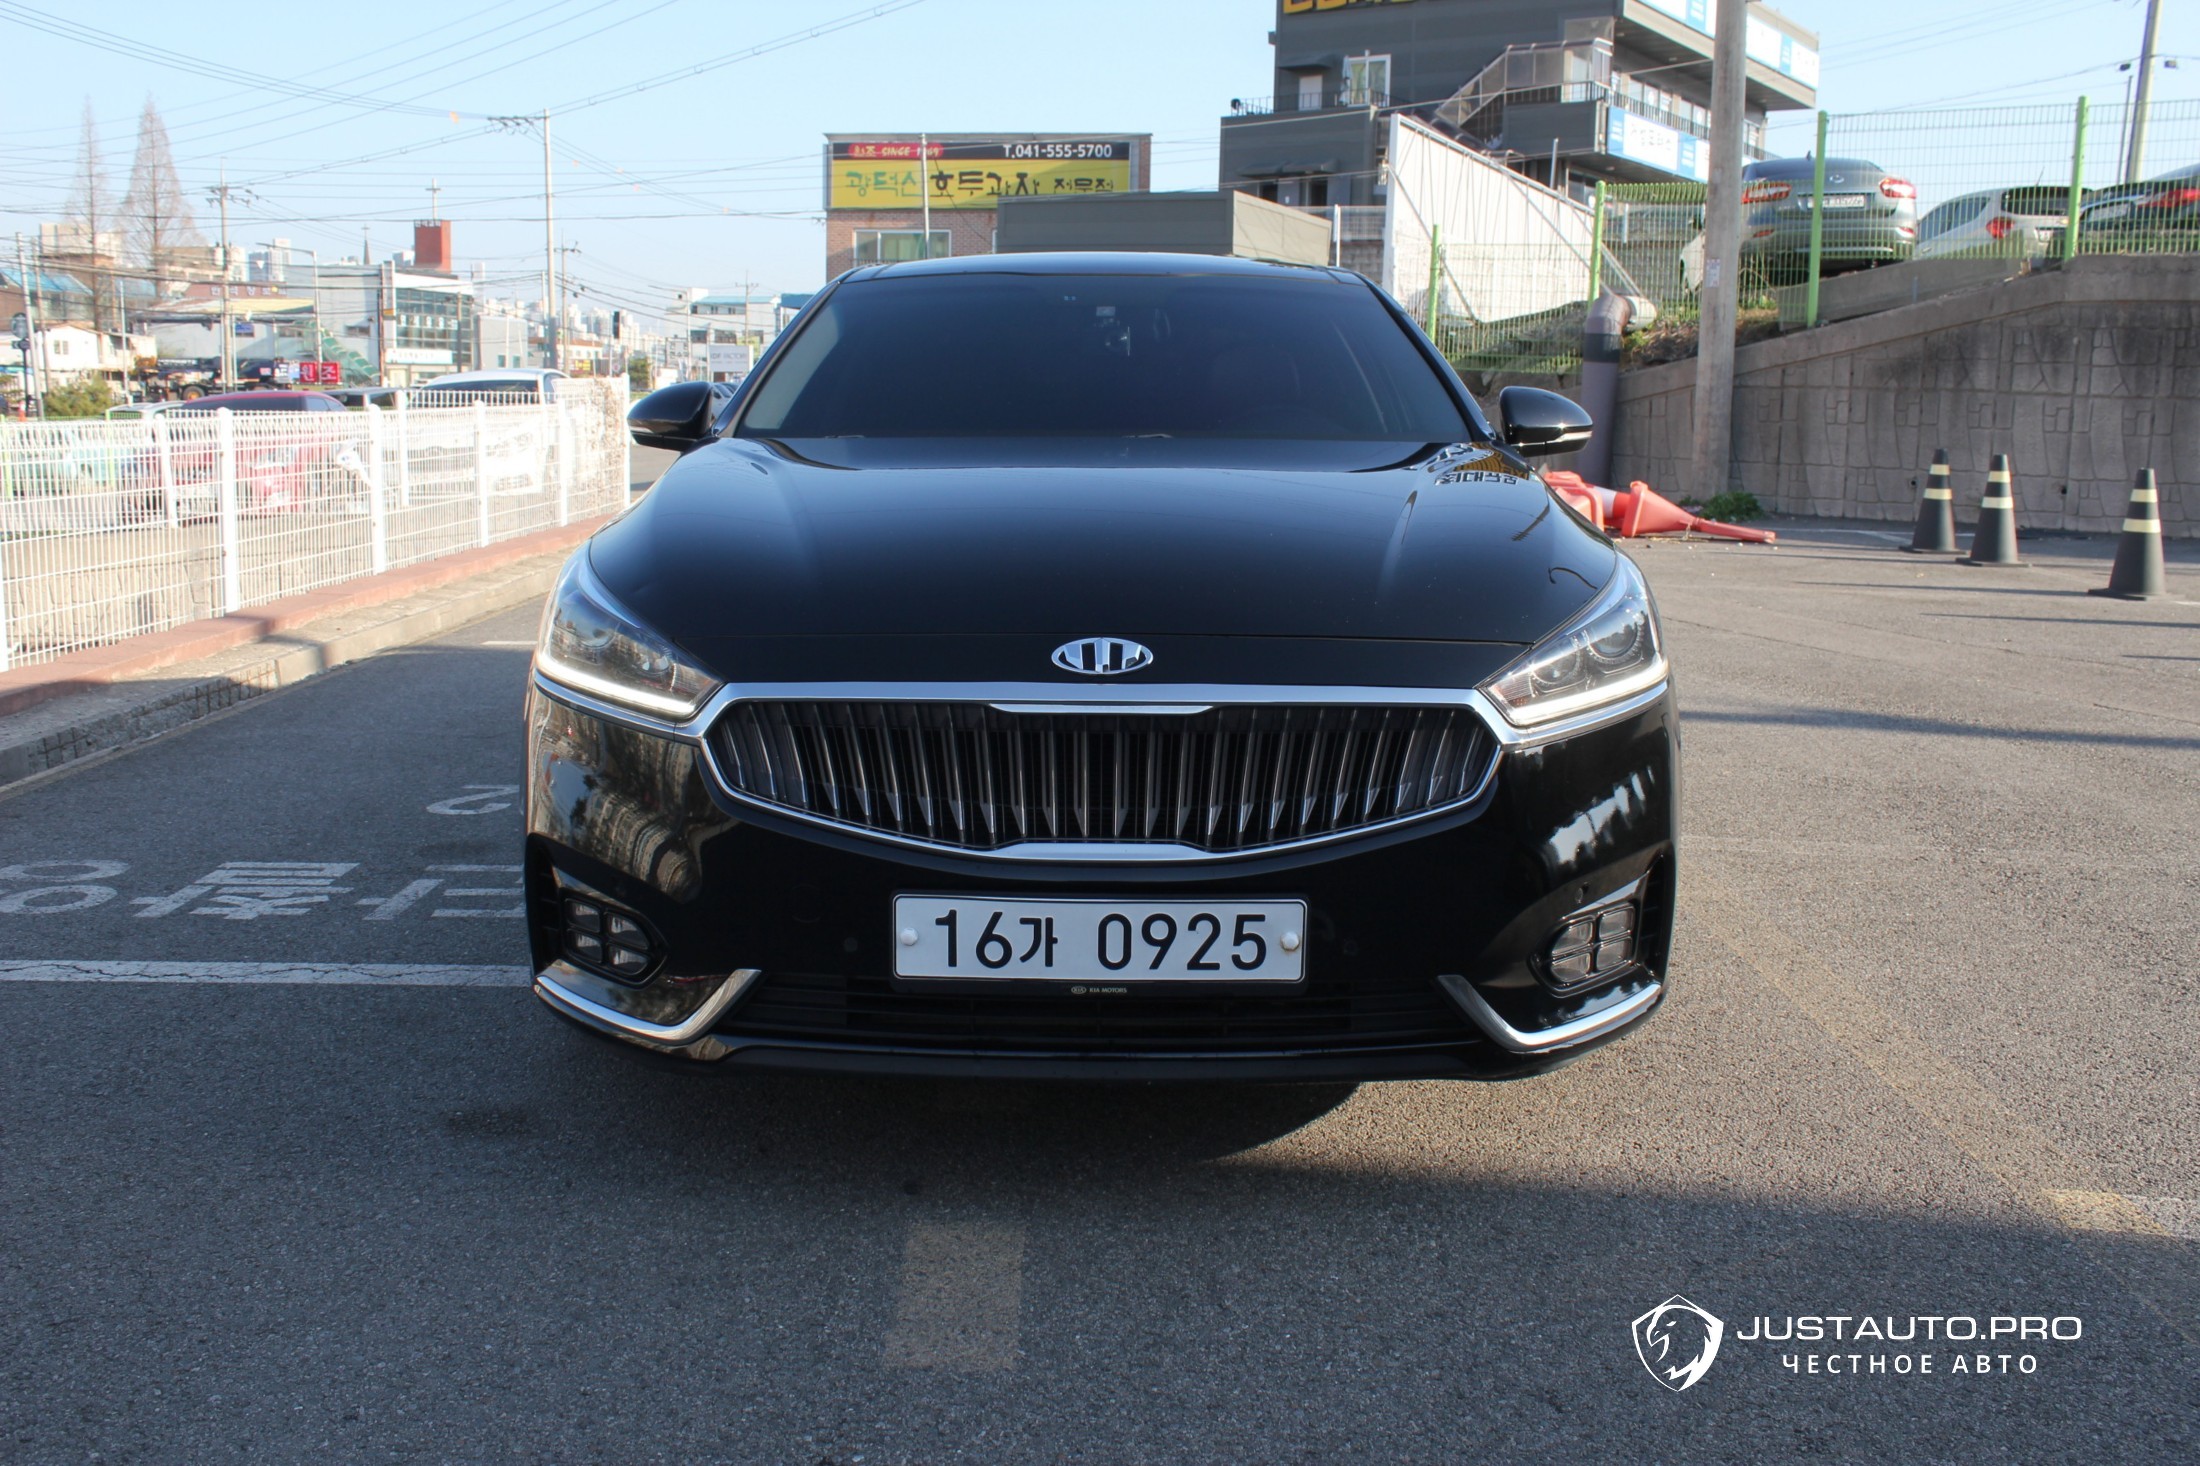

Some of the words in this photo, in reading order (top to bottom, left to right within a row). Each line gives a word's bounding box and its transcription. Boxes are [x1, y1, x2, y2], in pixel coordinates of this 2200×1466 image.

[916, 146, 940, 157] 169
[1003, 143, 1113, 159] T.041-555-5700
[929, 170, 1040, 197] 호두과자
[934, 908, 1059, 970] 16가
[1096, 911, 1267, 971] 0925
